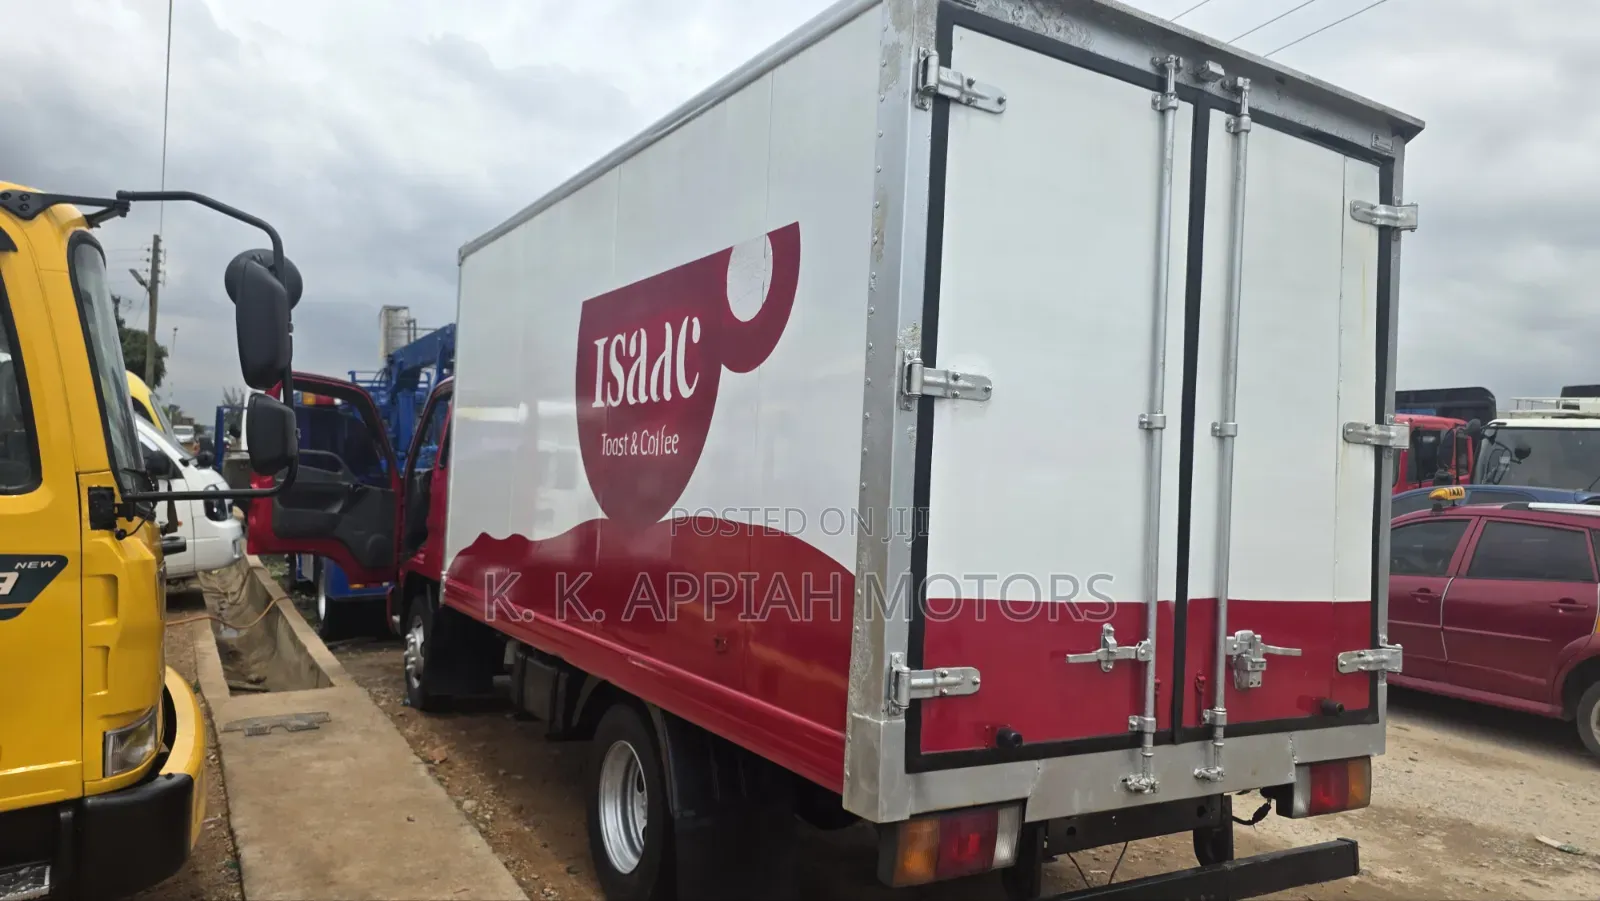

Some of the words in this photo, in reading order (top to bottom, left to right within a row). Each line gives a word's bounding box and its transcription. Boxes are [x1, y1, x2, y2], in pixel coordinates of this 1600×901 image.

[602, 432, 629, 456] Toast
[630, 431, 638, 455] &
[1449, 488, 1463, 497] TAXI
[14, 560, 57, 569] NEW
